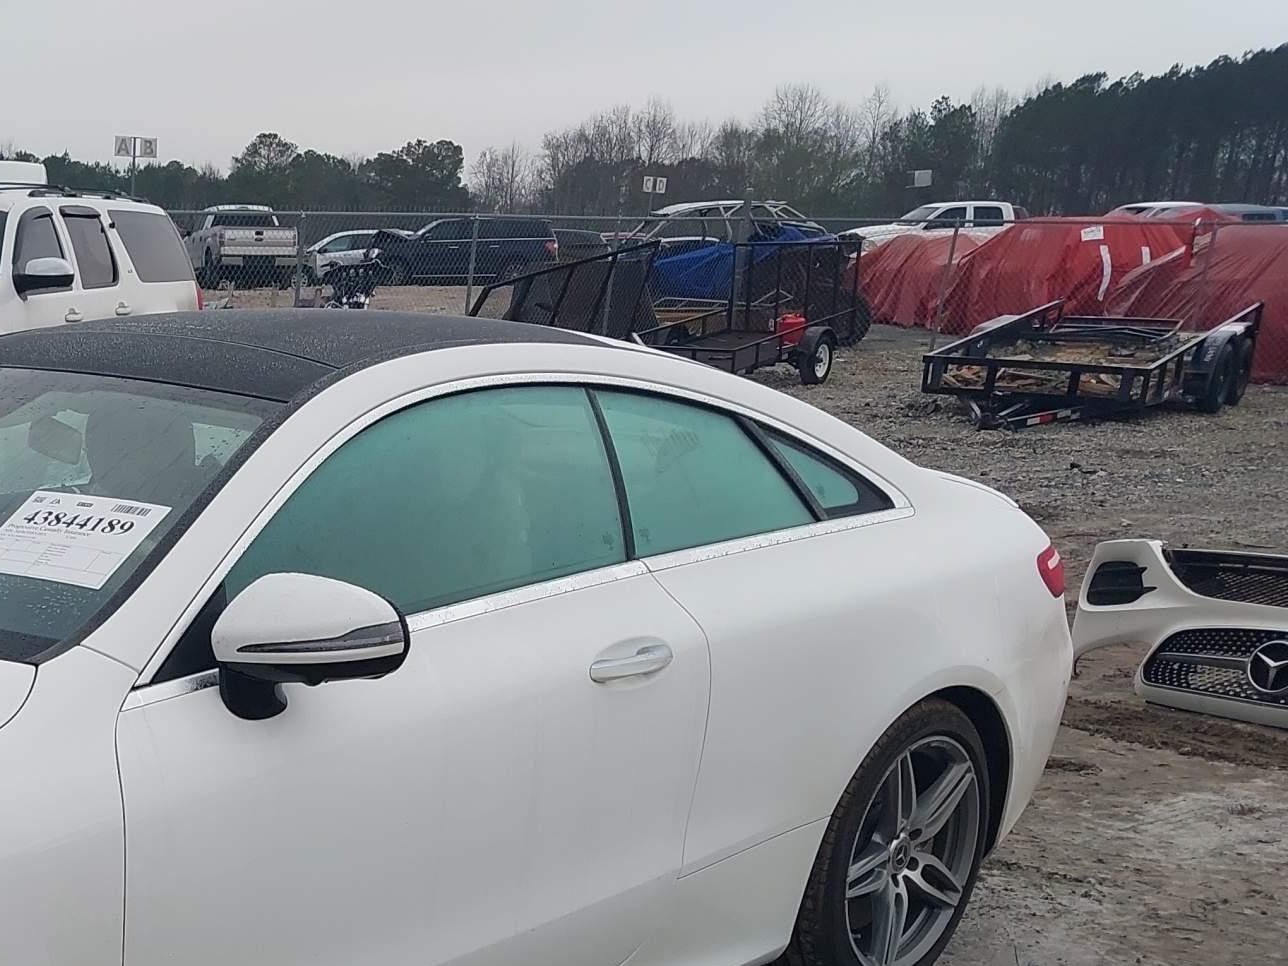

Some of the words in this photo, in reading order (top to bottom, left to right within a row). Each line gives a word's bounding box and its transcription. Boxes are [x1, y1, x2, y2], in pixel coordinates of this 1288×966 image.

[117, 138, 130, 155] A
[143, 140, 154, 155] B
[23, 509, 135, 535] 43844189
